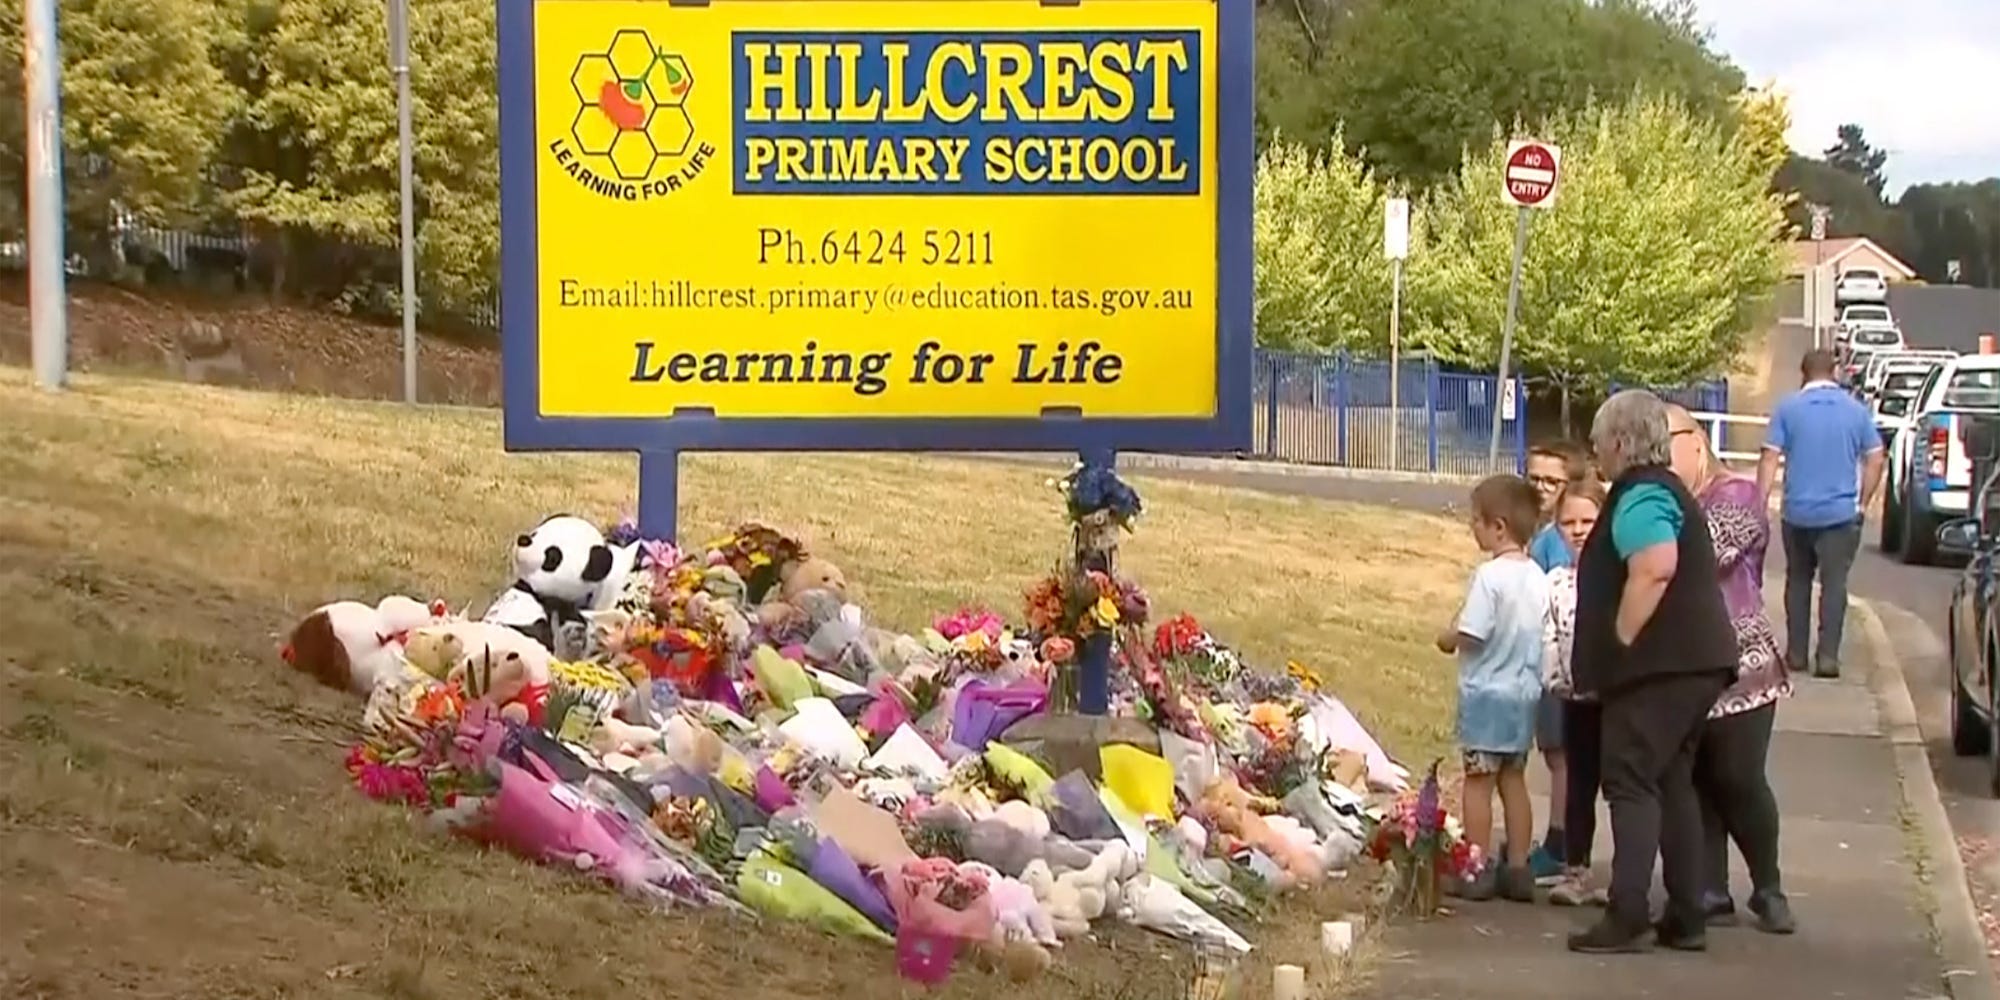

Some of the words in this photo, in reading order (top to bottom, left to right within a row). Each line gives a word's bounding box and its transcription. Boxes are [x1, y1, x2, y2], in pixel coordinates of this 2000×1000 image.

[743, 38, 1188, 123] HILLCREST
[549, 138, 637, 201] LEARNING
[642, 174, 683, 200] FOR
[680, 141, 716, 181] LIFE
[744, 137, 970, 183] PRIMARY
[984, 137, 1188, 184] SCHOOL
[1525, 154, 1541, 167] NO
[1511, 182, 1548, 196] ENTRY
[758, 228, 907, 265] Ph.6424
[922, 230, 995, 266] 5211
[559, 279, 1193, 314] Email:hillcrest.primary@education.tas.gov.au
[629, 341, 892, 396] Learning
[908, 341, 995, 385] for
[1011, 341, 1124, 385] Life
